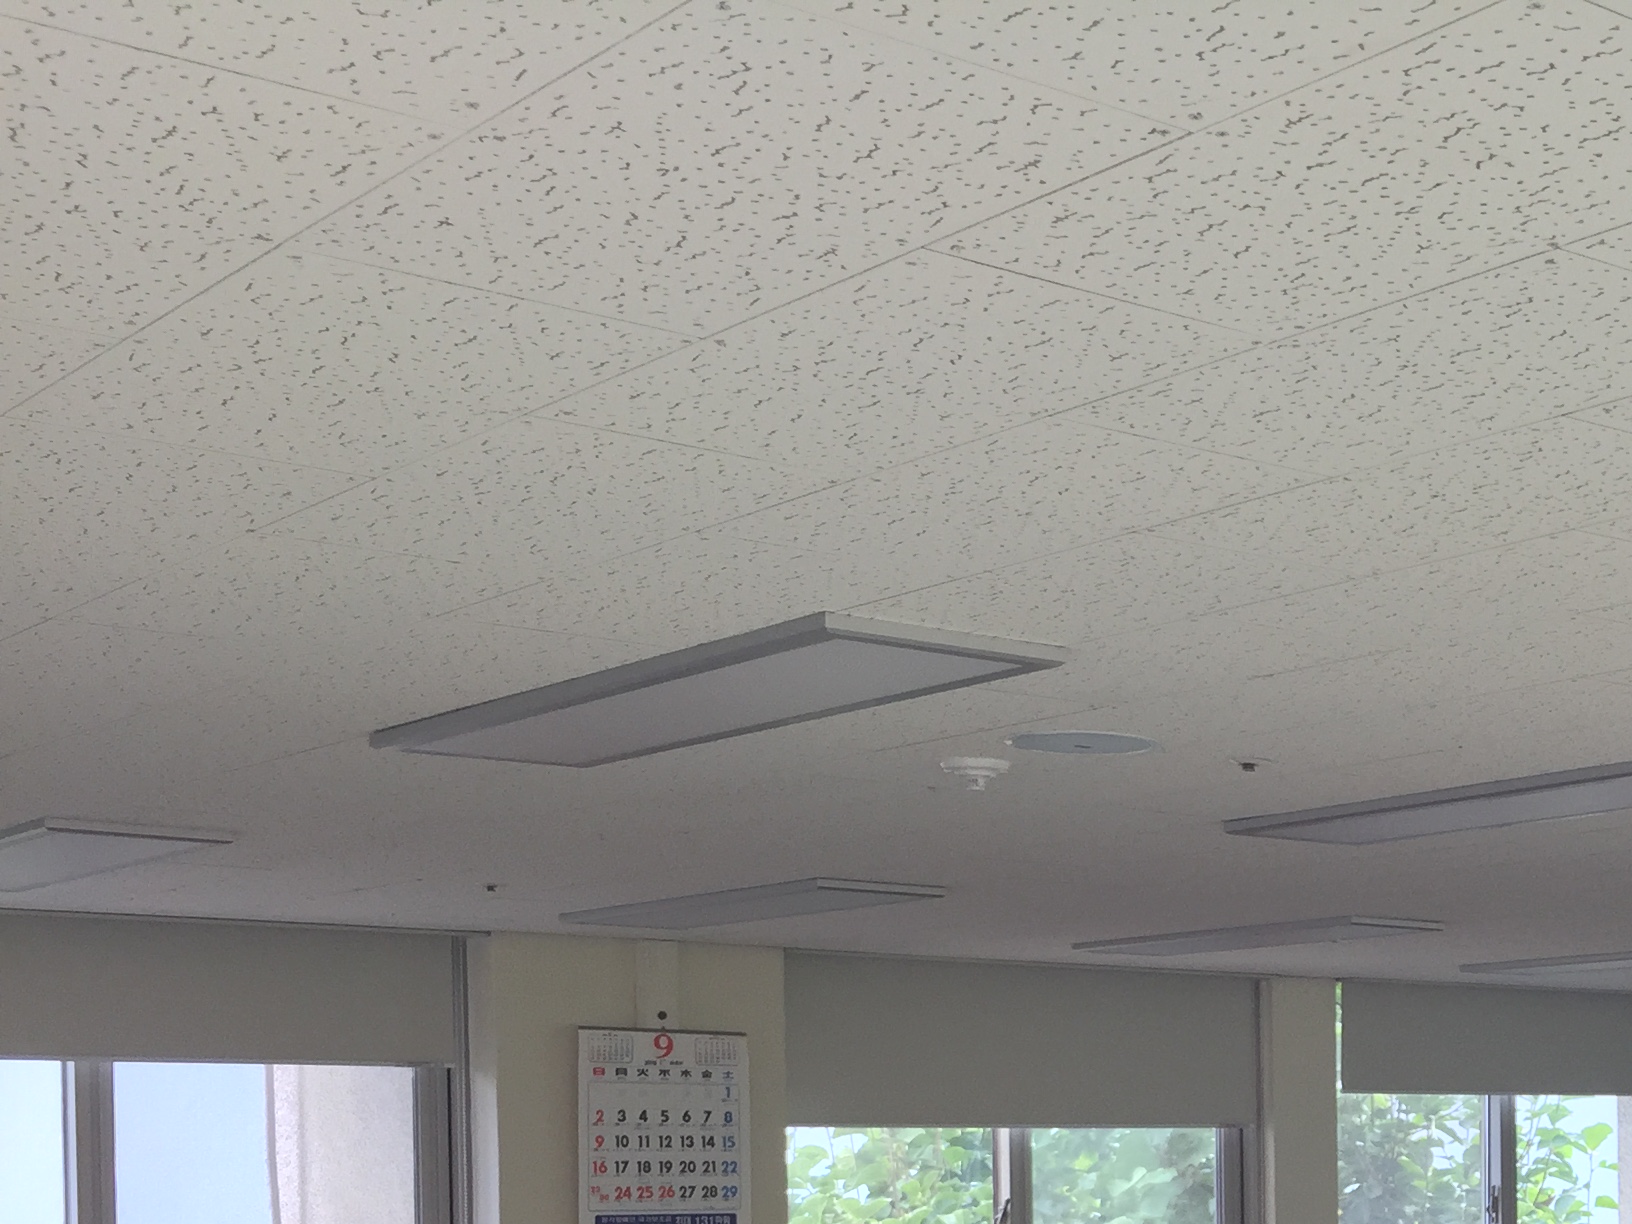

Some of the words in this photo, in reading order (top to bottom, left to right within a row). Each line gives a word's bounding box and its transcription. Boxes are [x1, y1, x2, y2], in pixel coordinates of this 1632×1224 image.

[653, 1033, 674, 1059] 9
[636, 1068, 650, 1077] 火
[722, 1071, 734, 1080] 土
[725, 1087, 731, 1098] 1
[595, 1110, 605, 1122] 2
[617, 1110, 627, 1122] 3
[639, 1110, 649, 1122] 4
[660, 1111, 670, 1123] 5
[682, 1111, 691, 1123] 6
[703, 1111, 712, 1123] 7
[724, 1112, 733, 1124] 8
[594, 1136, 605, 1148] 9
[615, 1136, 629, 1148] 10
[638, 1136, 650, 1148] 11
[659, 1136, 672, 1148] 12
[680, 1136, 695, 1148] 13
[702, 1136, 716, 1149] 14
[722, 1136, 735, 1148] 15
[592, 1161, 608, 1174] 16
[614, 1160, 629, 1174] 17
[637, 1161, 651, 1174] 18
[659, 1161, 673, 1174] 19
[679, 1161, 696, 1174] 20
[702, 1161, 717, 1174] 21
[721, 1162, 738, 1174] 22
[614, 1186, 631, 1199] 24
[637, 1186, 654, 1199] 25
[658, 1186, 675, 1199] 26
[679, 1186, 696, 1199] 27
[702, 1186, 717, 1199] 28
[721, 1186, 738, 1198] 29
